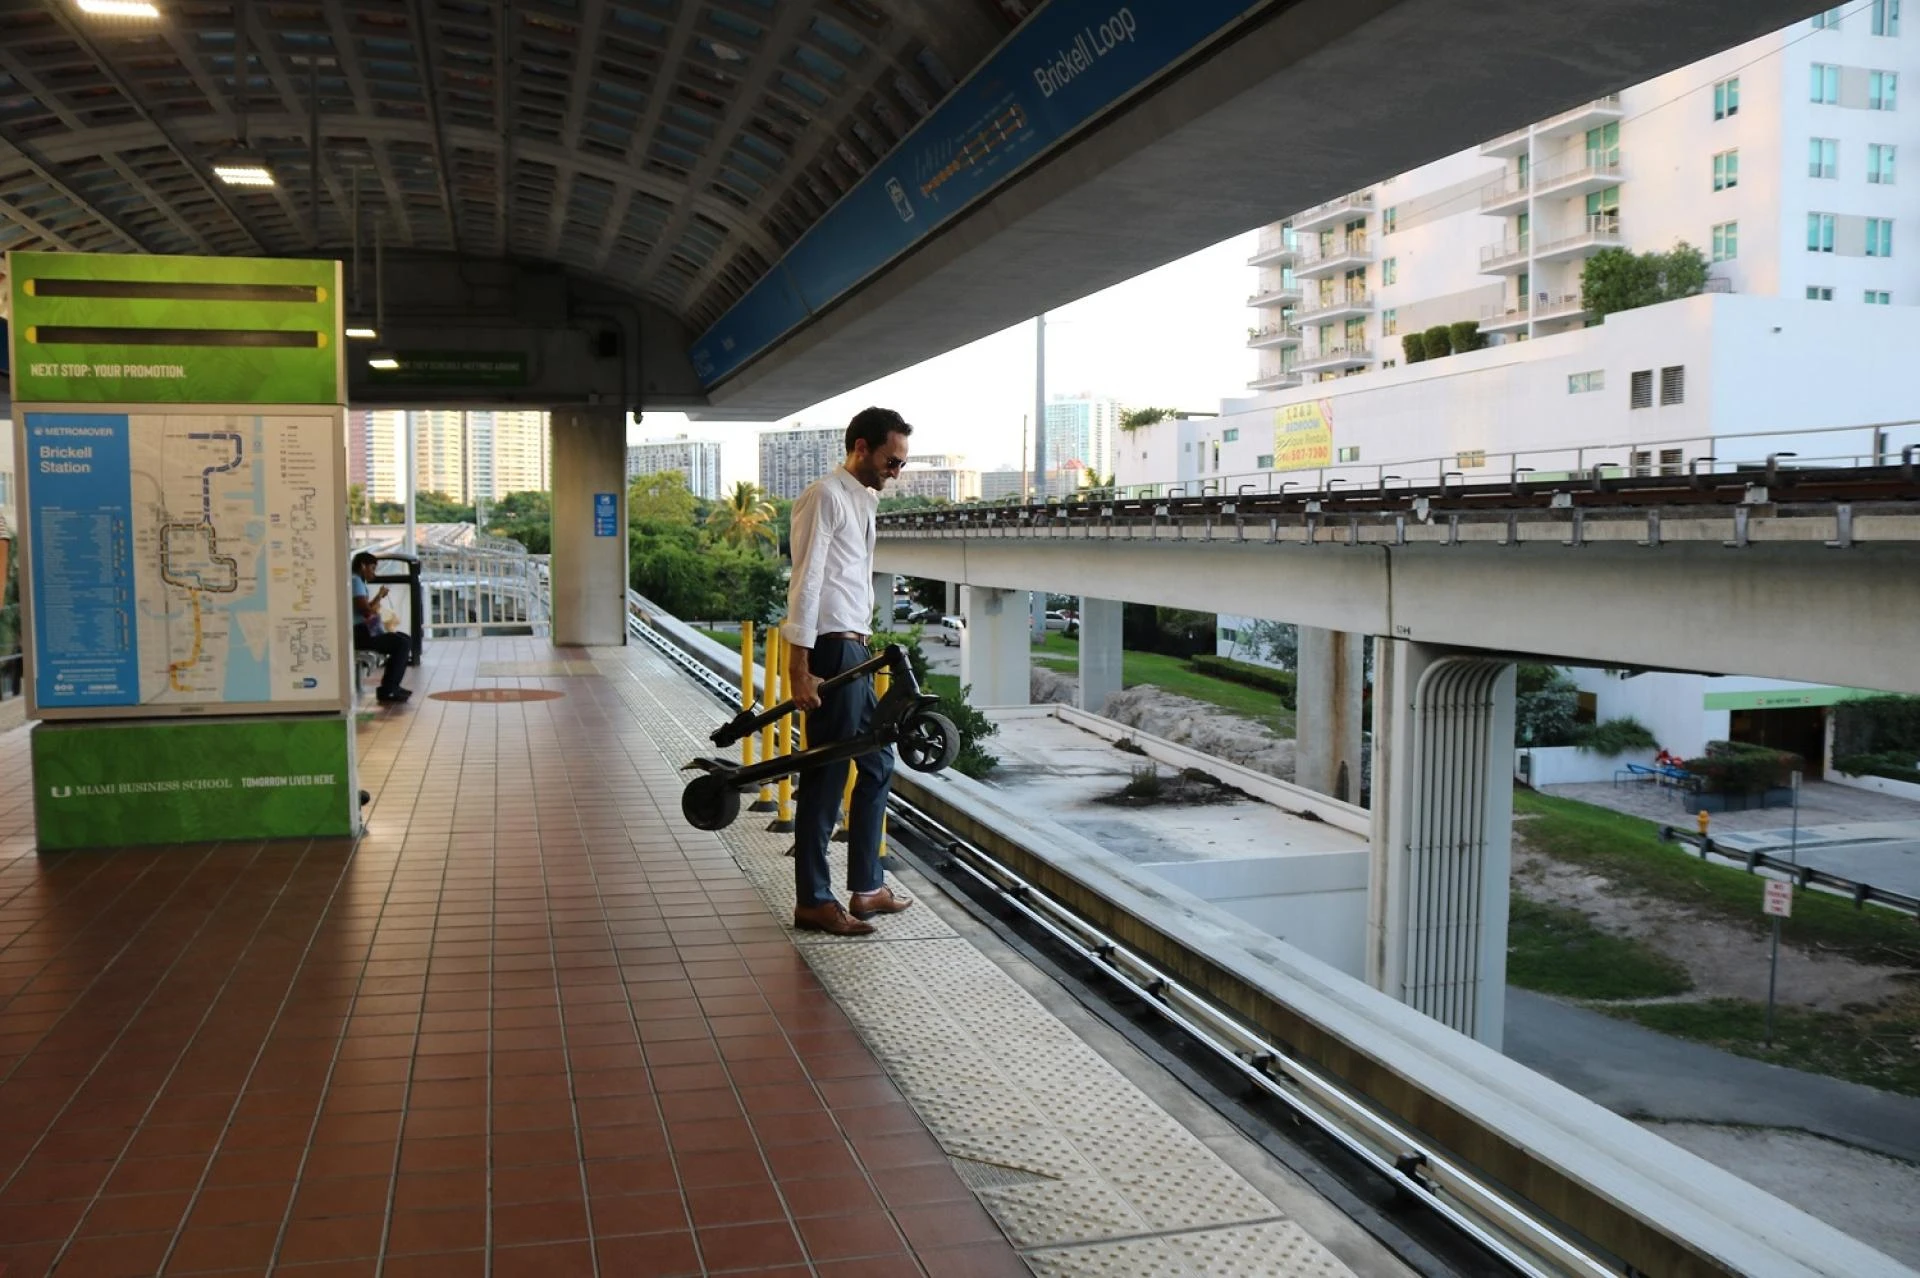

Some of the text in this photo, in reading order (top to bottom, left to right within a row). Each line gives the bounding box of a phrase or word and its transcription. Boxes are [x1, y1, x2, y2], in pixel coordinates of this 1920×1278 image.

[1033, 7, 1137, 98] Brickell Loop
[31, 364, 186, 378] NEXT STOP: YOUR PROMOTION.
[45, 427, 114, 437] METROMOVER
[40, 446, 93, 458] Brickell
[40, 461, 91, 473] Station
[76, 783, 115, 796] MIAMI
[118, 780, 180, 794] BUSINESS
[182, 778, 232, 790] SCHOOL
[242, 776, 287, 788] TOMORROW
